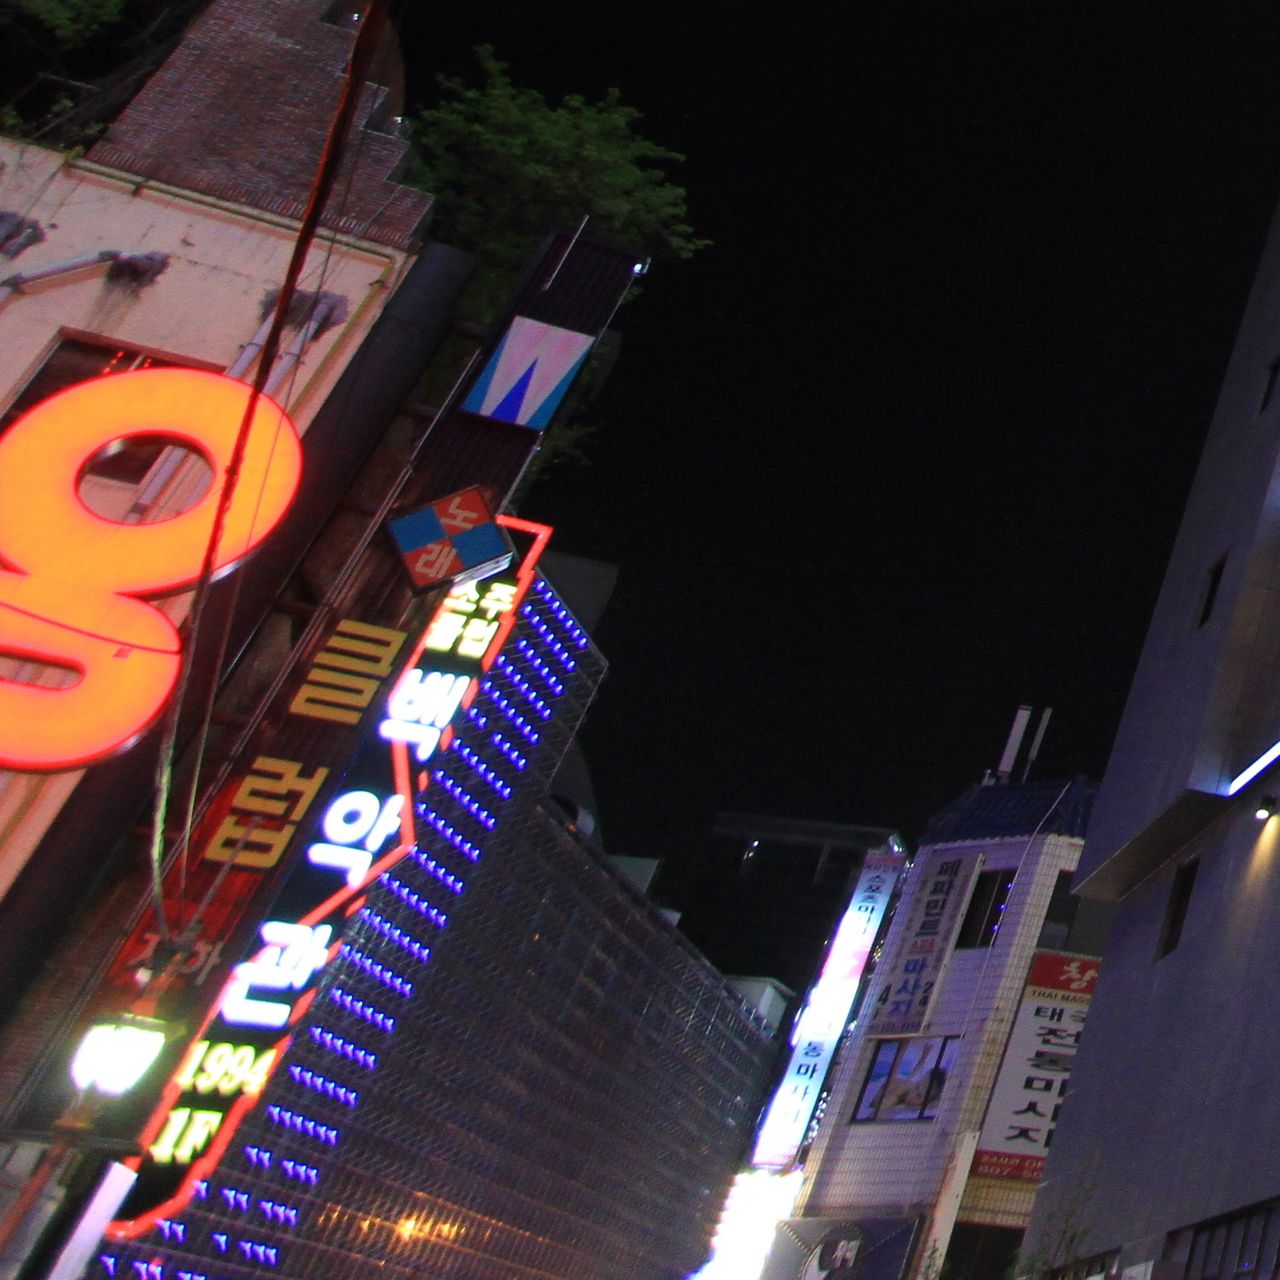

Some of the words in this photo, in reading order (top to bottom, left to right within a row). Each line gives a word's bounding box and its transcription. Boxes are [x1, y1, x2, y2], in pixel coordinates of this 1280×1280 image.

[415, 497, 478, 578] 노래
[220, 668, 470, 1029] 백악관
[175, 1041, 277, 1098] 1994
[149, 1108, 223, 1164] 1F
